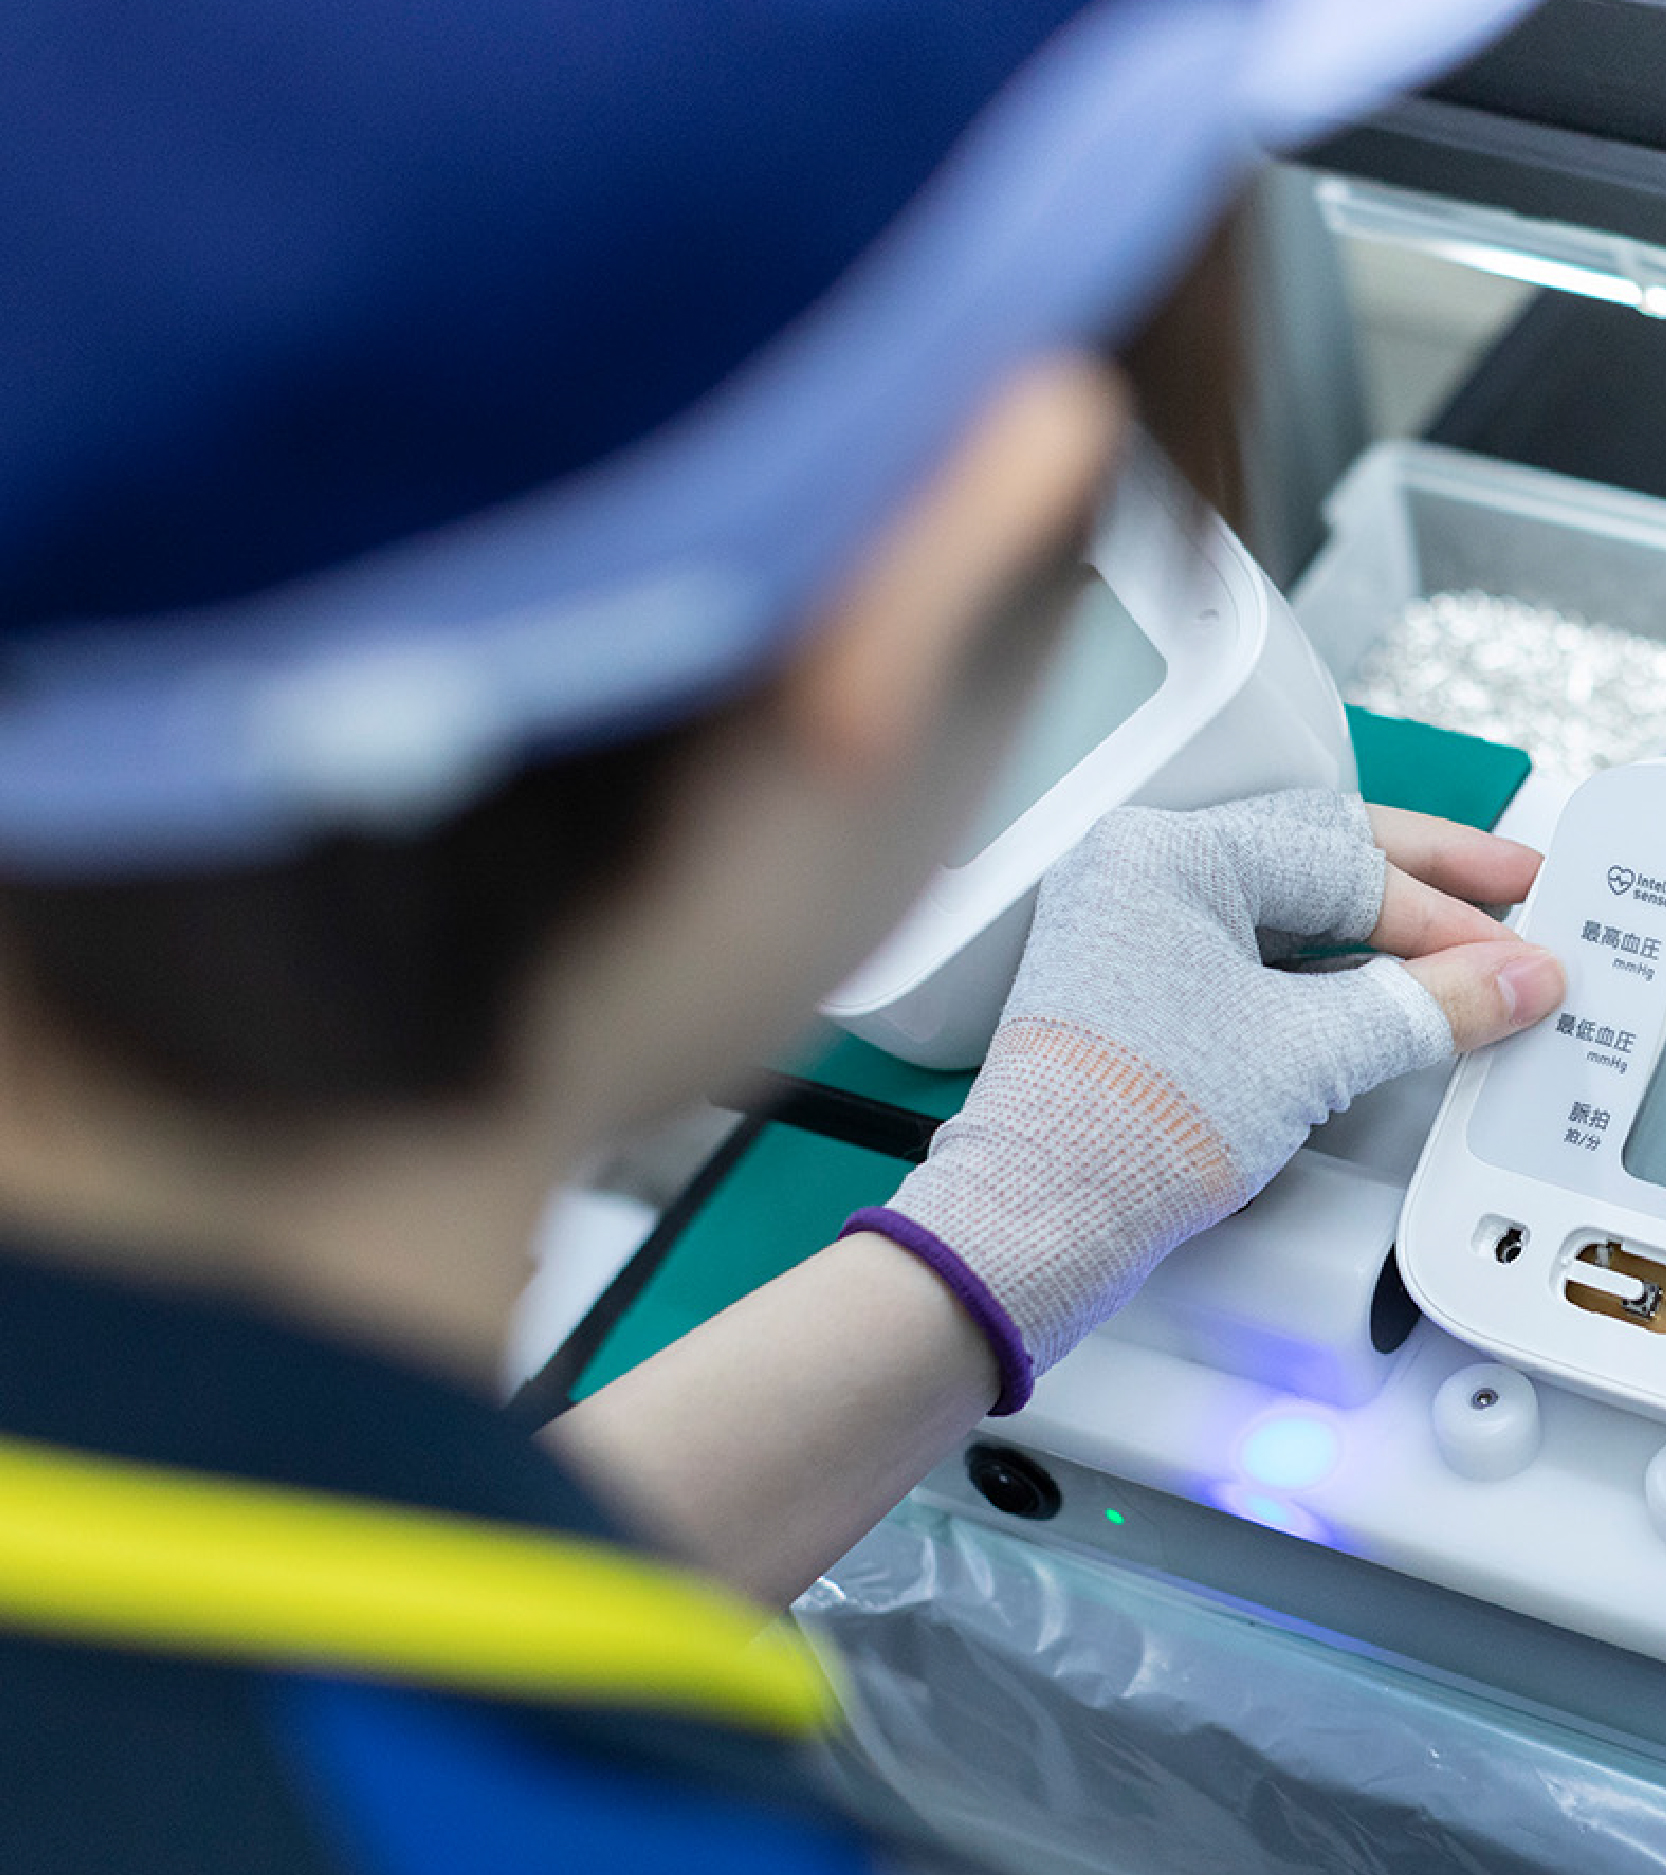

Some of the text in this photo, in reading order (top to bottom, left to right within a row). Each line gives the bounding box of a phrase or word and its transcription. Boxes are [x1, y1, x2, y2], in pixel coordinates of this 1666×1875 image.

[1580, 919, 1662, 961] 最高血圧
[1611, 957, 1656, 981] mmHg
[1555, 1012, 1637, 1054] 最低血圧
[1586, 1050, 1628, 1075] mmHg
